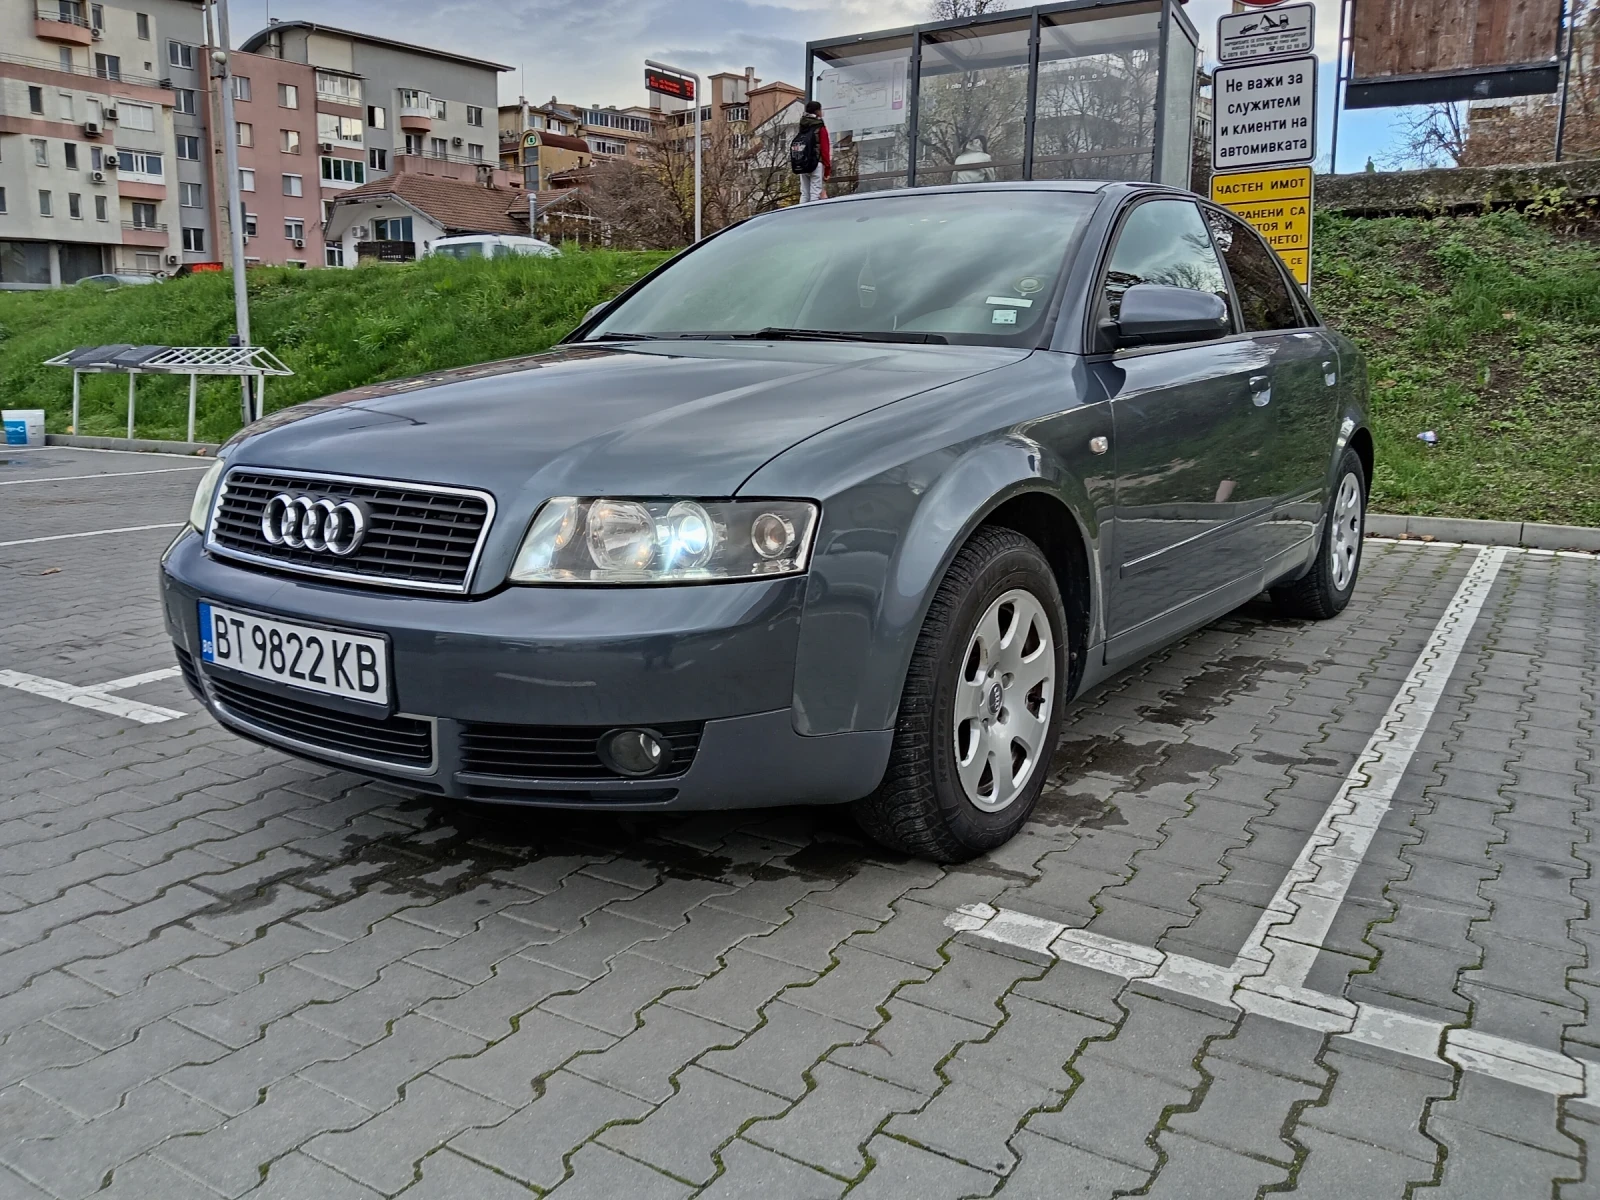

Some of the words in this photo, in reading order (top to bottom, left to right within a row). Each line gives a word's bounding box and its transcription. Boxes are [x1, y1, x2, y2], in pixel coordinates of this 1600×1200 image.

[1226, 78, 1243, 93] Не
[1247, 76, 1283, 90] важи
[1287, 73, 1303, 85] за
[1227, 95, 1301, 116] служители
[1220, 126, 1228, 136] и
[1232, 119, 1287, 135] клиенти
[1291, 116, 1307, 128] на
[1220, 138, 1307, 157] автомивката
[1216, 181, 1263, 194] ЧАСТЕН
[1270, 178, 1306, 190] ИМОТ
[1234, 208, 1284, 220] РАНЕНИ
[1290, 206, 1306, 216] СА
[1285, 221, 1293, 230] И
[1265, 234, 1303, 244] НЕТО!
[1290, 257, 1303, 265] СЕ
[202, 639, 213, 653] BG
[251, 624, 327, 685] 9822
